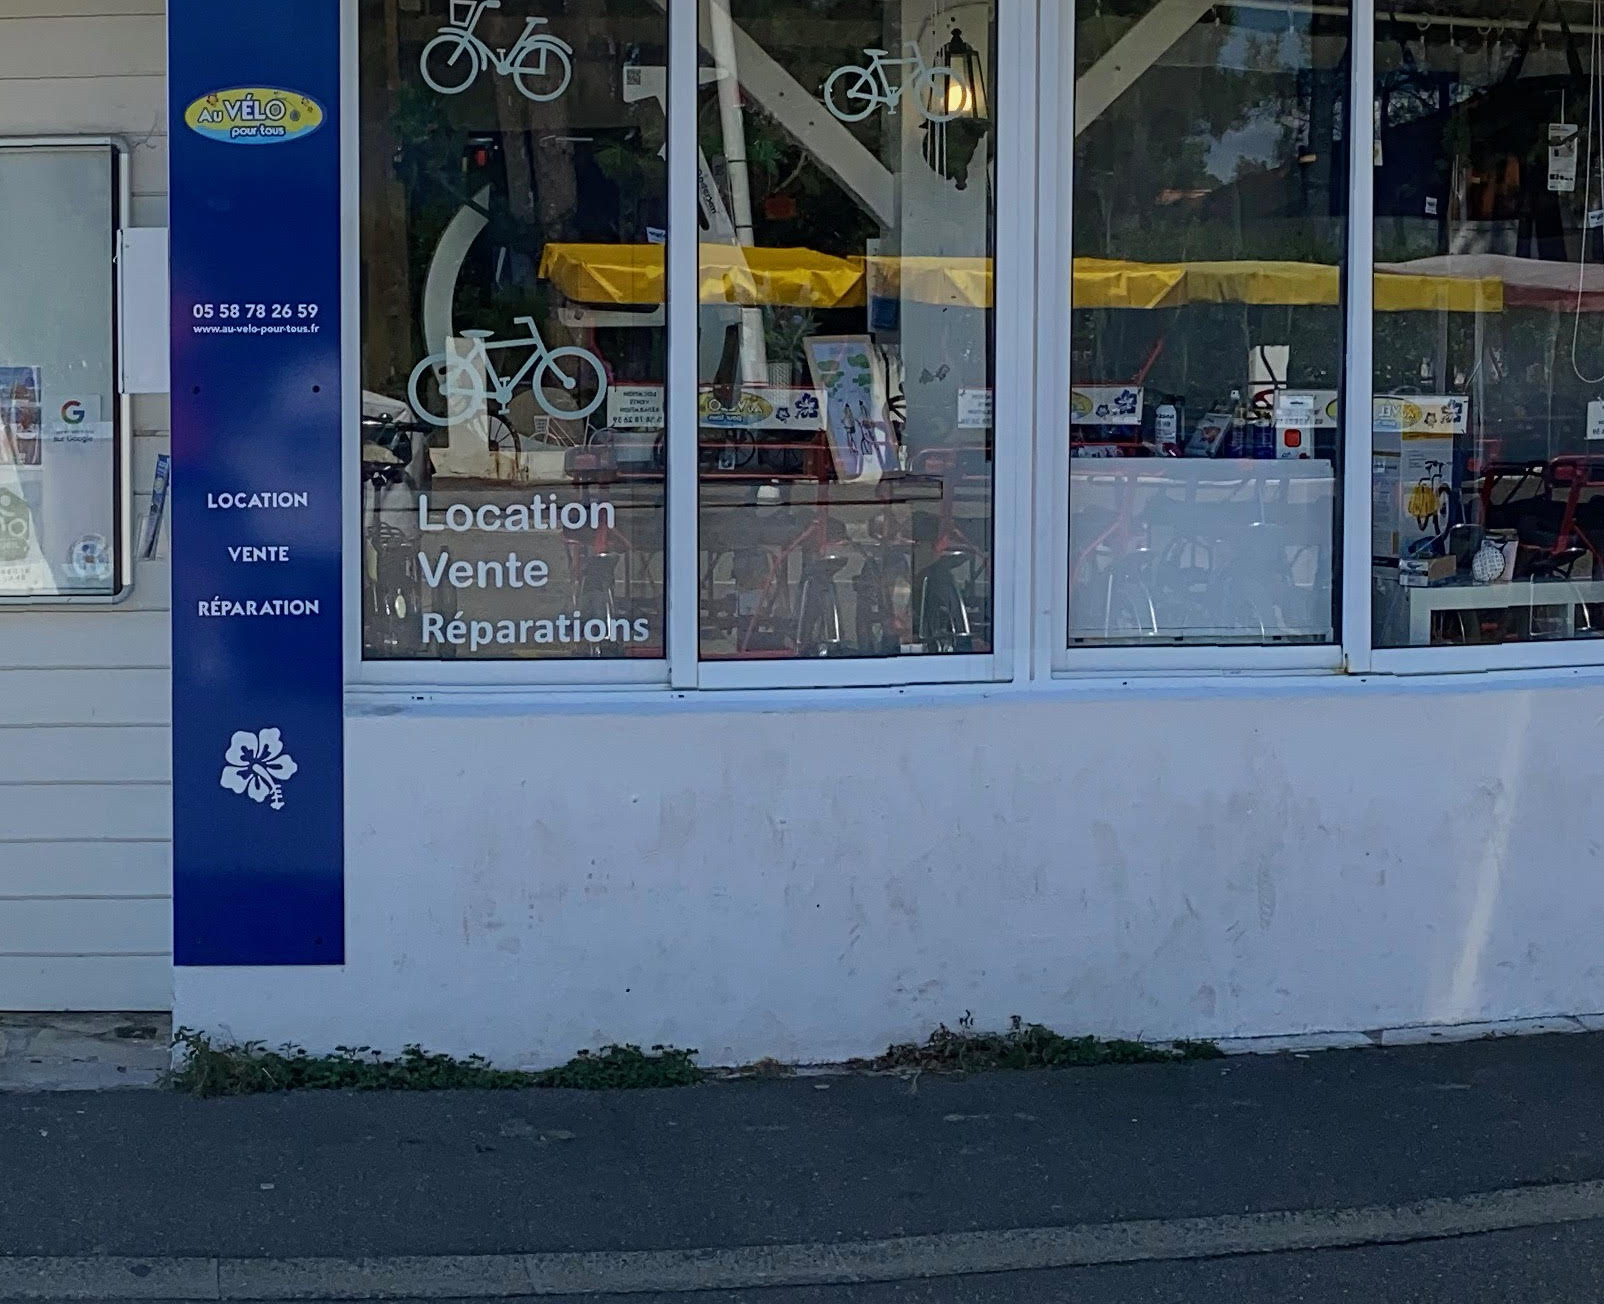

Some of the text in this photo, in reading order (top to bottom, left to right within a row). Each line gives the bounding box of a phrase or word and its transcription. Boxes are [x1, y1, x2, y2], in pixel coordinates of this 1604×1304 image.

[223, 93, 286, 121] VÉLO
[231, 124, 285, 138] pour tous
[192, 303, 319, 319] 05 58 78 26 59
[193, 323, 320, 335] www.au-velo-pour-tous.fr
[207, 491, 308, 509] LOCATION
[418, 495, 616, 533] Location
[227, 545, 290, 562] VENTE
[416, 551, 549, 589] Vente
[198, 596, 319, 617] RÉPARATION
[420, 609, 651, 645] Réparations
